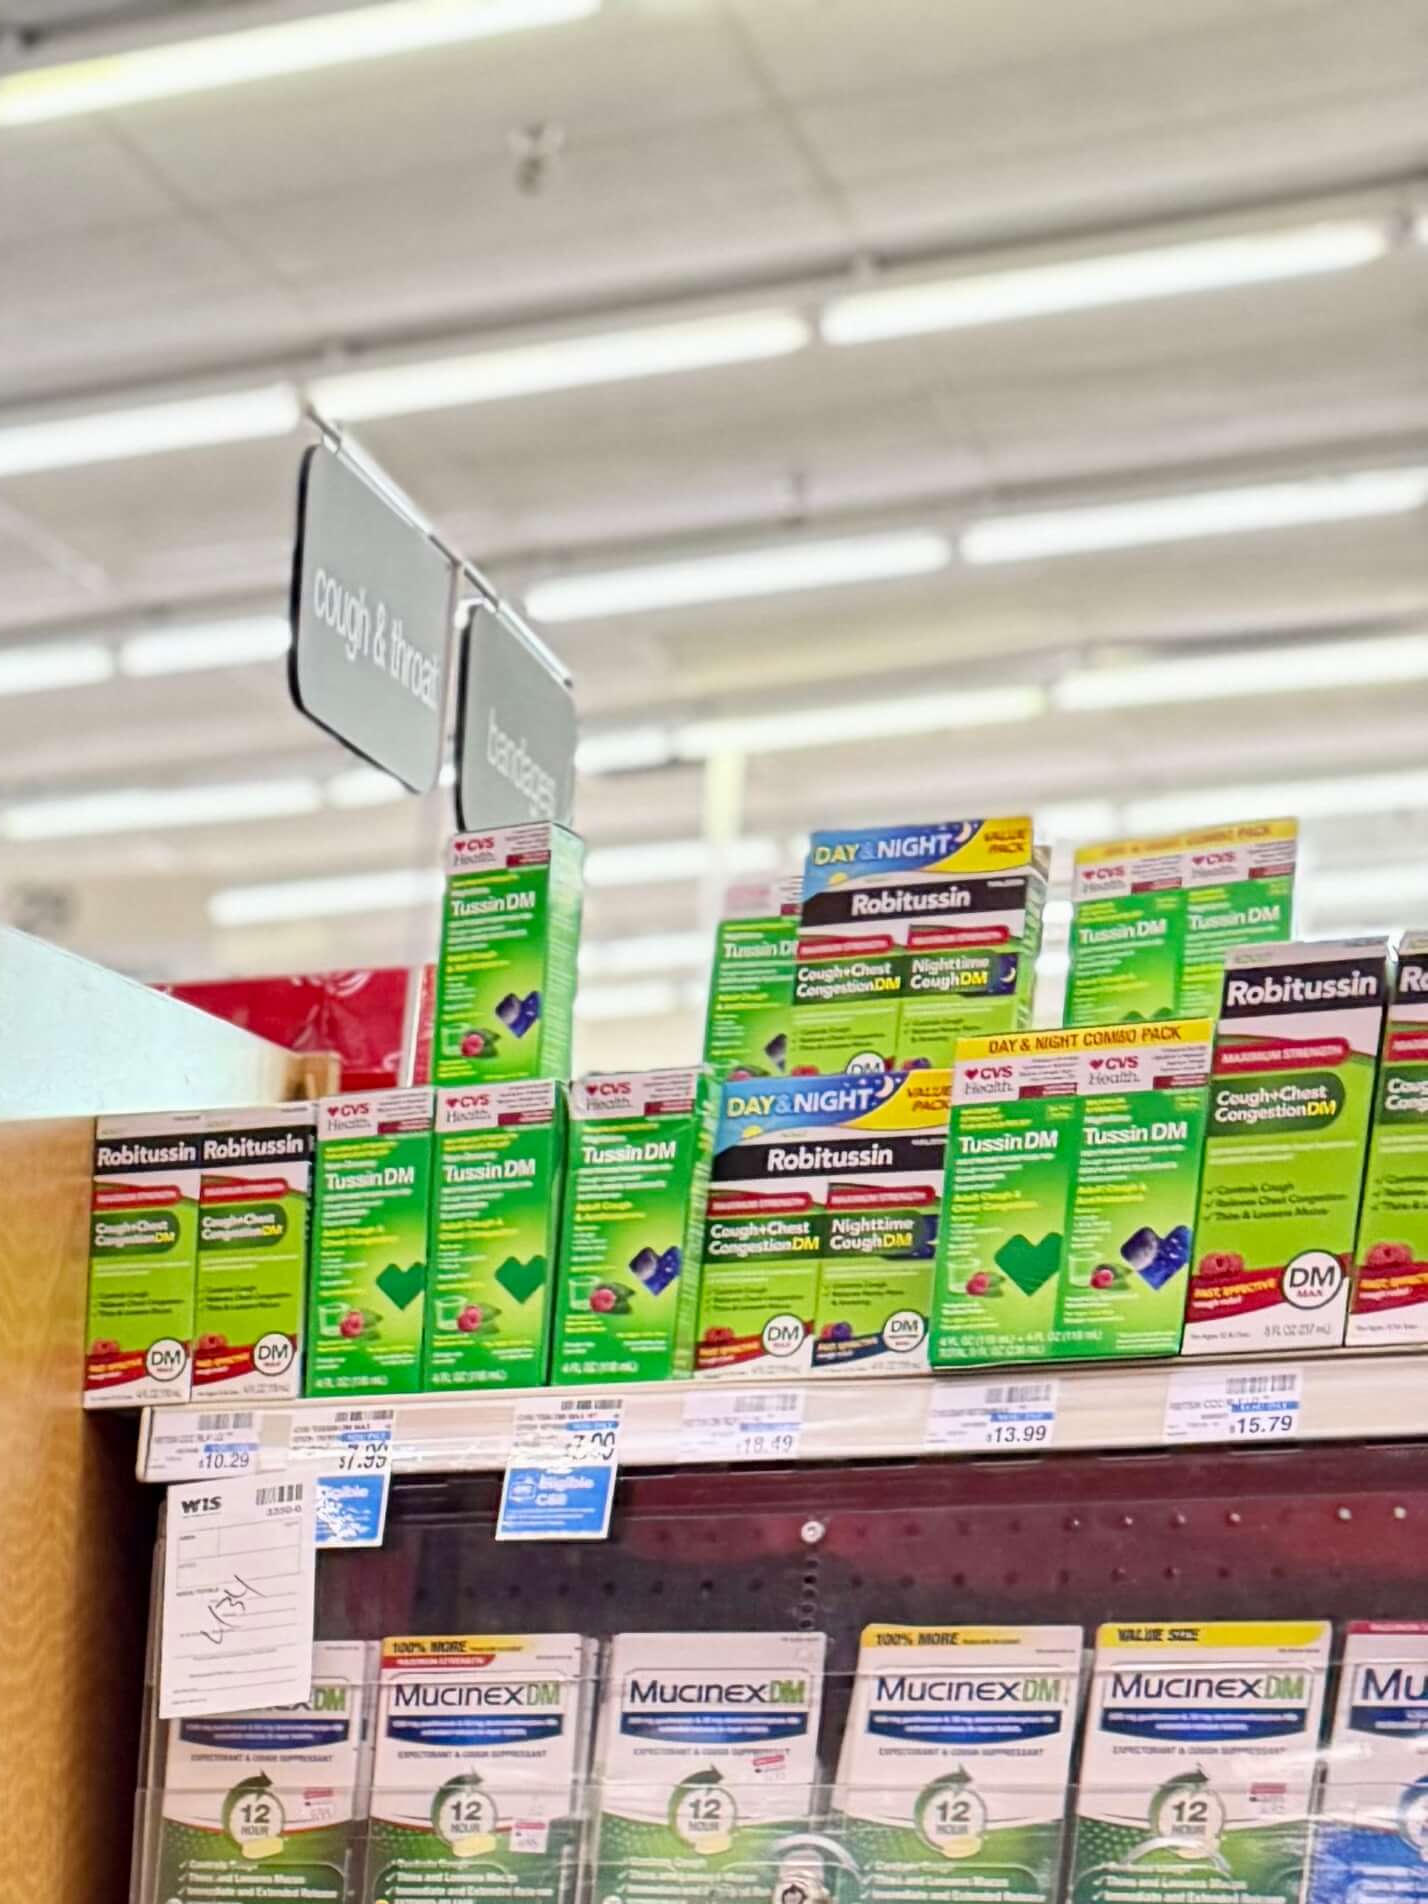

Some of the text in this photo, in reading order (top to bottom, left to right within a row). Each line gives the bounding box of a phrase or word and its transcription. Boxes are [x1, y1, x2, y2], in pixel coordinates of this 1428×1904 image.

[313, 569, 440, 711] cough & throat
[1227, 972, 1377, 1006] Robitussin
[989, 1038, 1021, 1054] DAY
[1035, 1034, 1077, 1051] NIGHT
[1082, 1030, 1137, 1047] COMBO
[1143, 1027, 1181, 1043] PACK
[1217, 1086, 1328, 1107] Cough+Chest
[1216, 1101, 1337, 1122] CongestionDM
[97, 1143, 197, 1167] Robitussin
[767, 1145, 893, 1172] Robitussin
[325, 1166, 415, 1190] Tussin DM
[1230, 1415, 1293, 1435] $15.79
[182, 1496, 222, 1513] WIS
[1118, 1628, 1199, 1643] VALUE SIZE
[240, 1803, 271, 1825] 12
